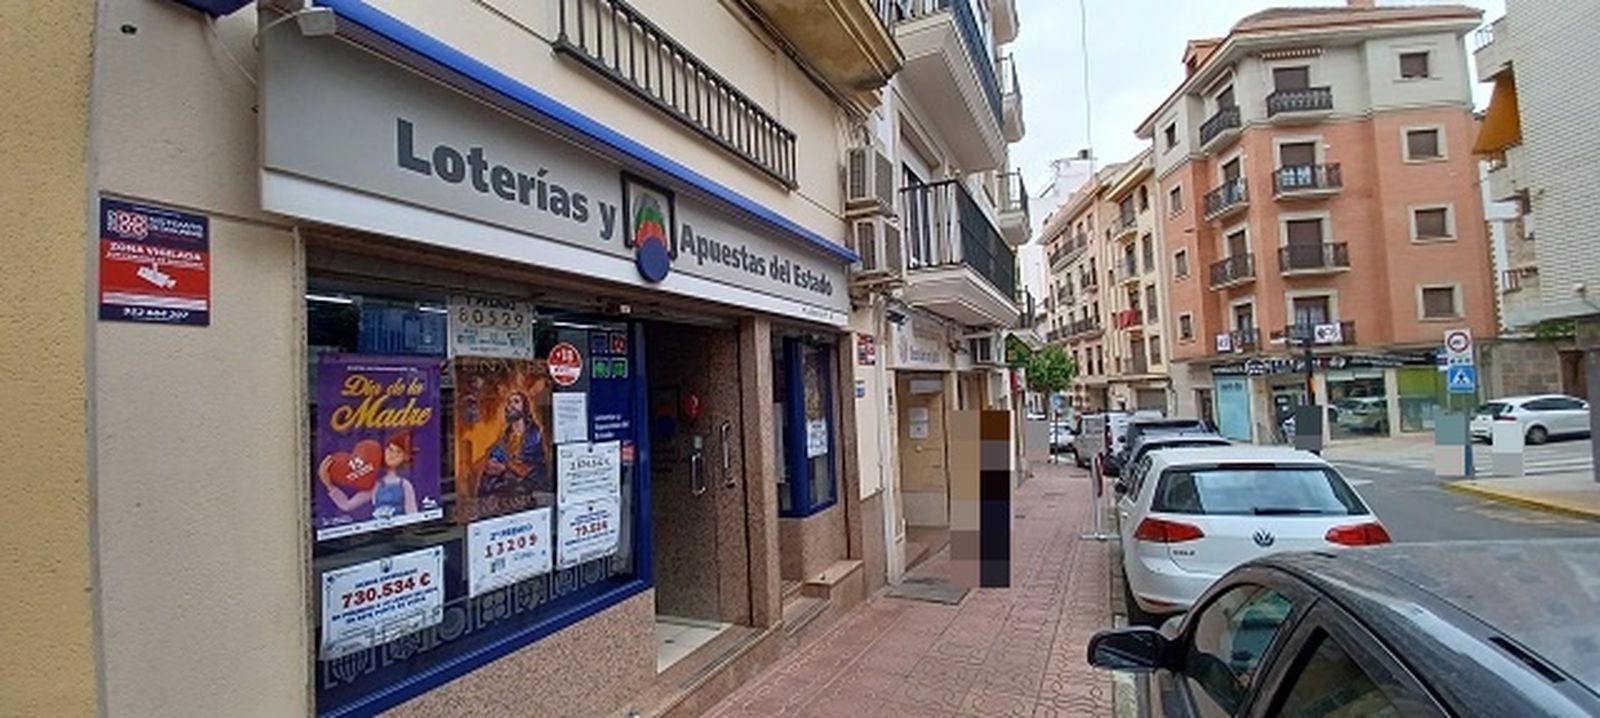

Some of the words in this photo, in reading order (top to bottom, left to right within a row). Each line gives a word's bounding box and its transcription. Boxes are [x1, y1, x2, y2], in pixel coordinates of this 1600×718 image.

[397, 117, 589, 224] Loterías
[597, 200, 617, 241] y
[109, 242, 144, 254] ZONA
[147, 246, 202, 262] VIGILADA
[680, 223, 766, 277] Apuestas
[769, 255, 791, 285] del
[794, 265, 833, 297] Estado
[459, 306, 524, 329] 80529
[386, 377, 406, 396] de
[406, 377, 424, 396] la
[330, 395, 433, 432] Madre
[484, 532, 538, 559] 13209
[341, 577, 416, 609] 730.534
